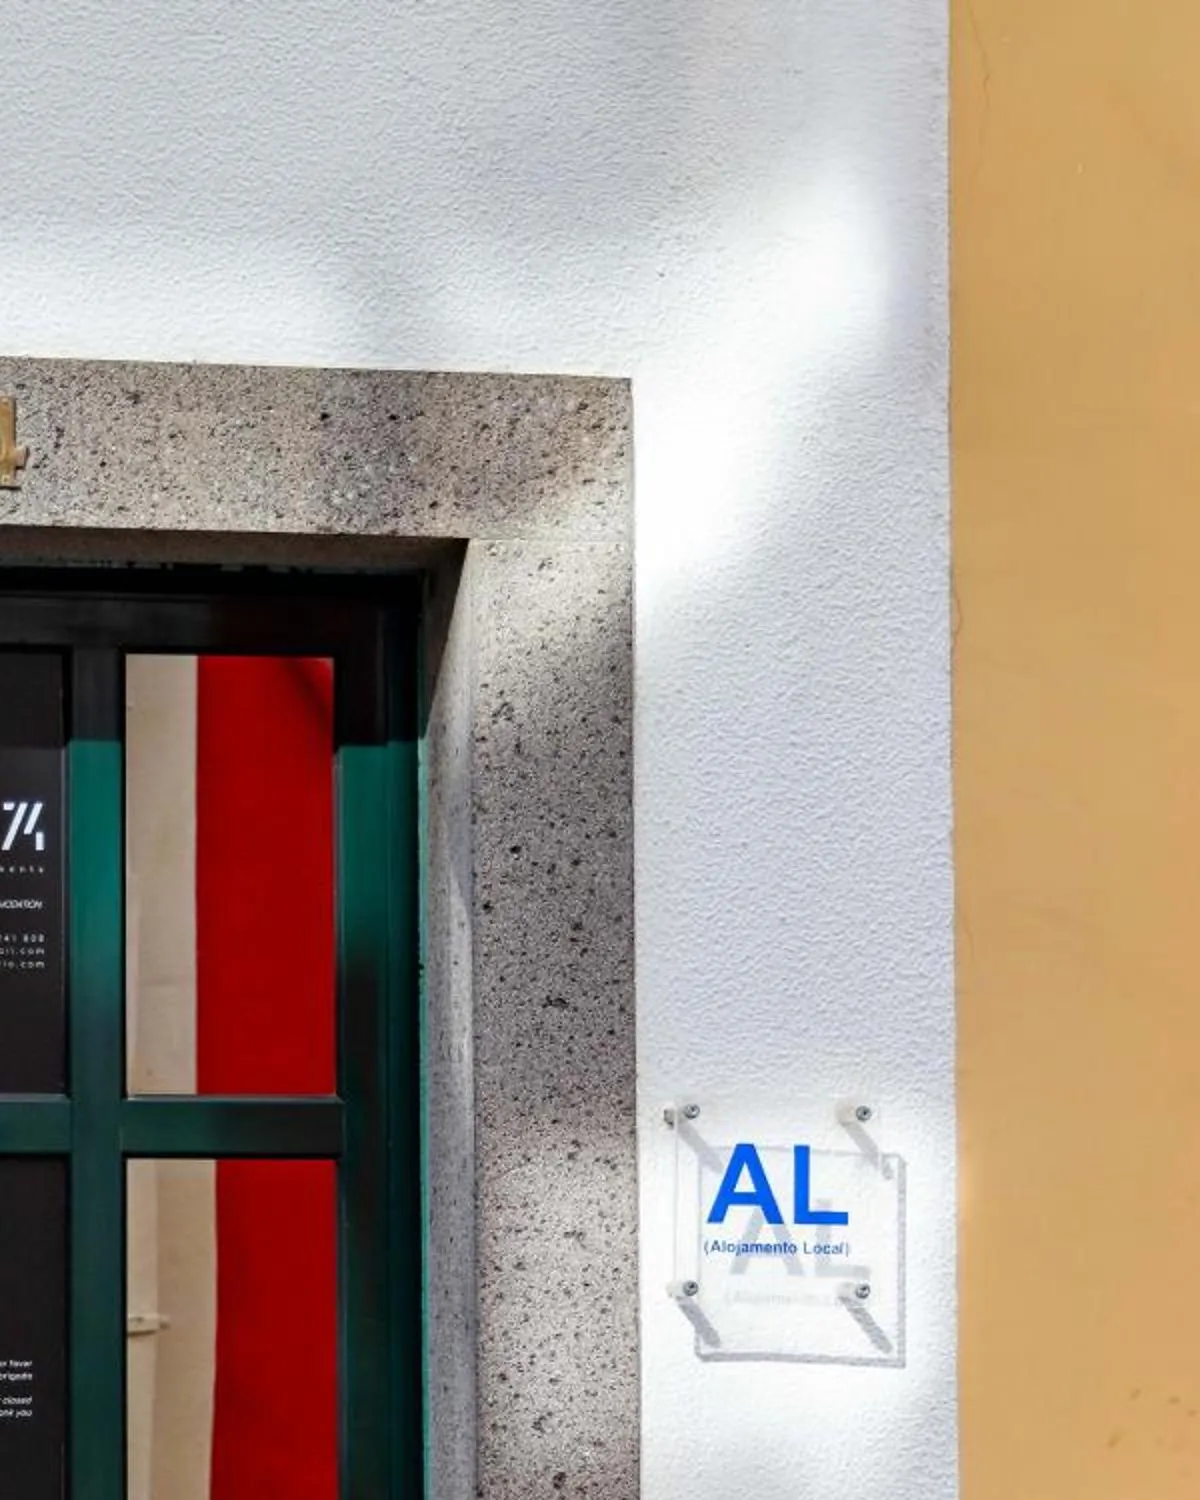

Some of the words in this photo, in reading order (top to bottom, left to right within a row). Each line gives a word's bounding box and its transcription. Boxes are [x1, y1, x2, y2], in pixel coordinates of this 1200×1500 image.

[0, 800, 45, 852] 74
[706, 1142, 849, 1226] AL
[703, 1239, 797, 1258] (Alojamento
[803, 1239, 850, 1258] Local)
[2, 1395, 32, 1406] closed
[15, 1409, 32, 1419] you
